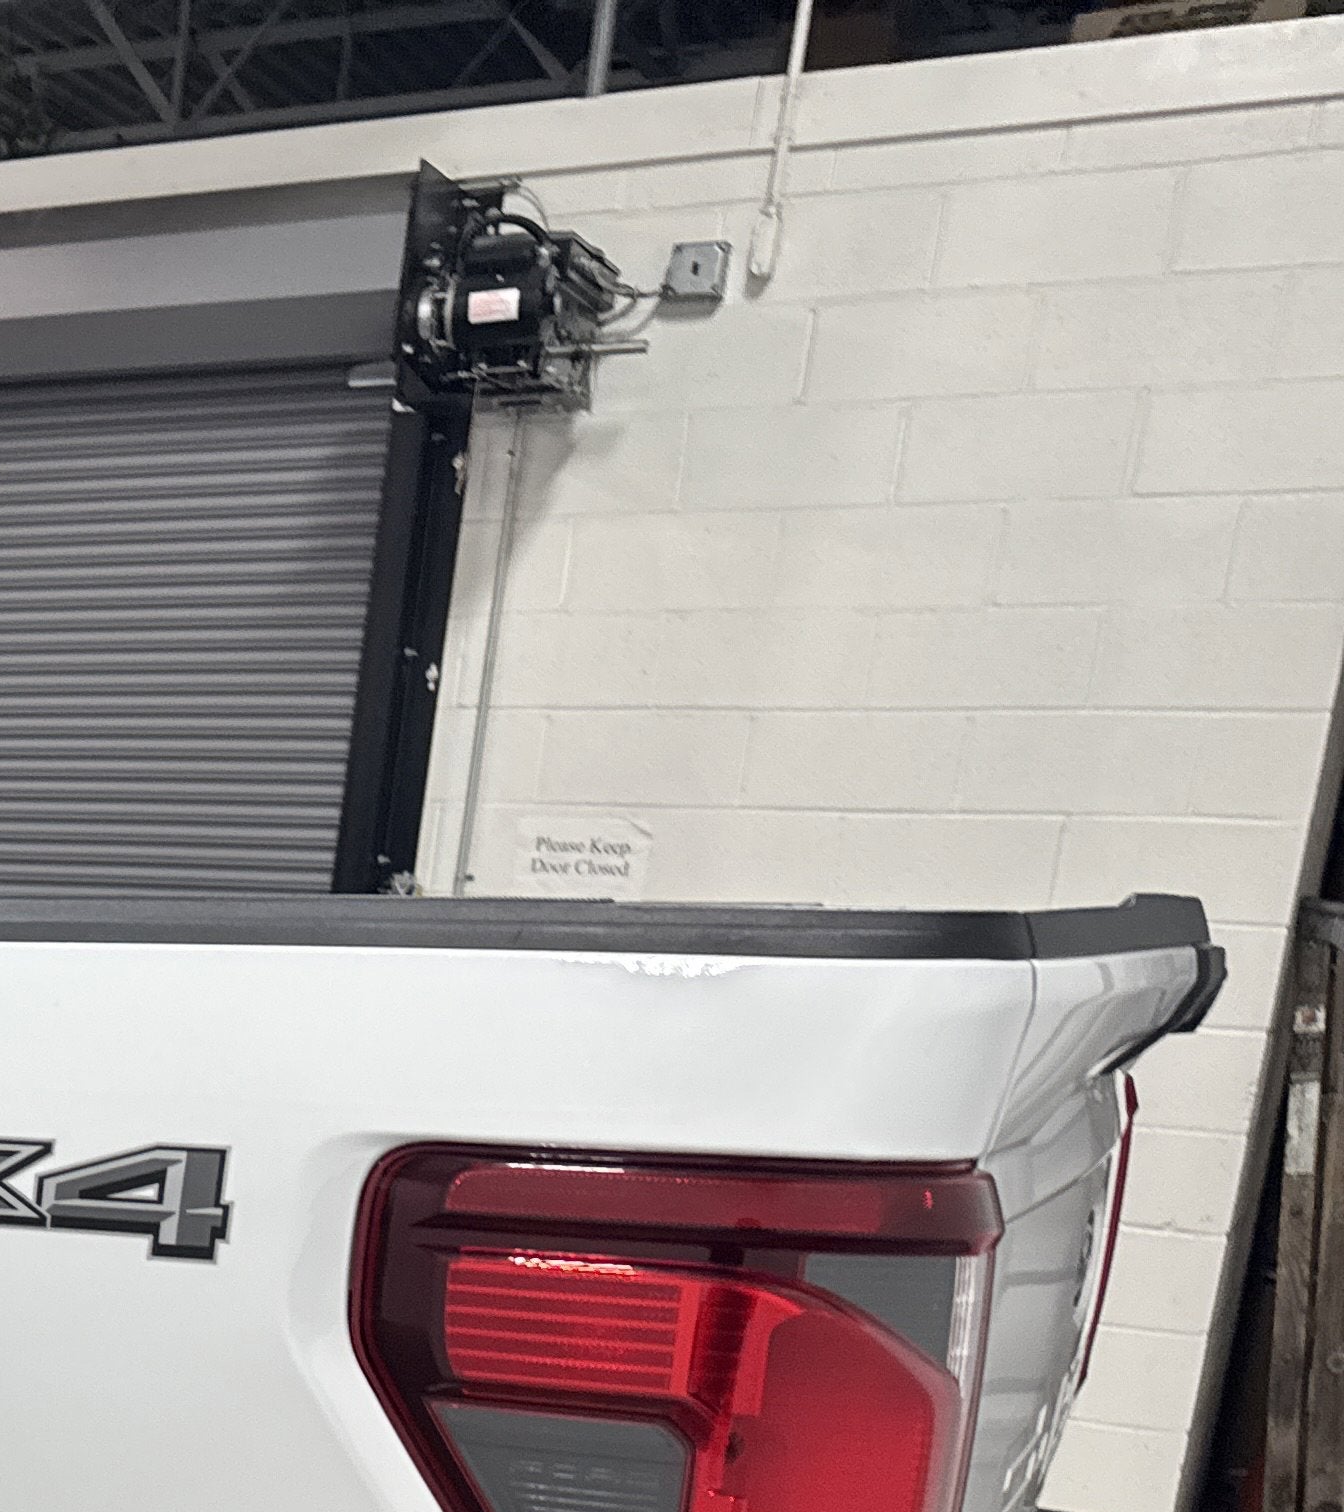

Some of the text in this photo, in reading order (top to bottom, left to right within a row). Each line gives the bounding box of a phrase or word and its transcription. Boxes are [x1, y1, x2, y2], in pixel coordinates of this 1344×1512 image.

[534, 833, 632, 858] Please Keep
[530, 857, 630, 878] Door Closed
